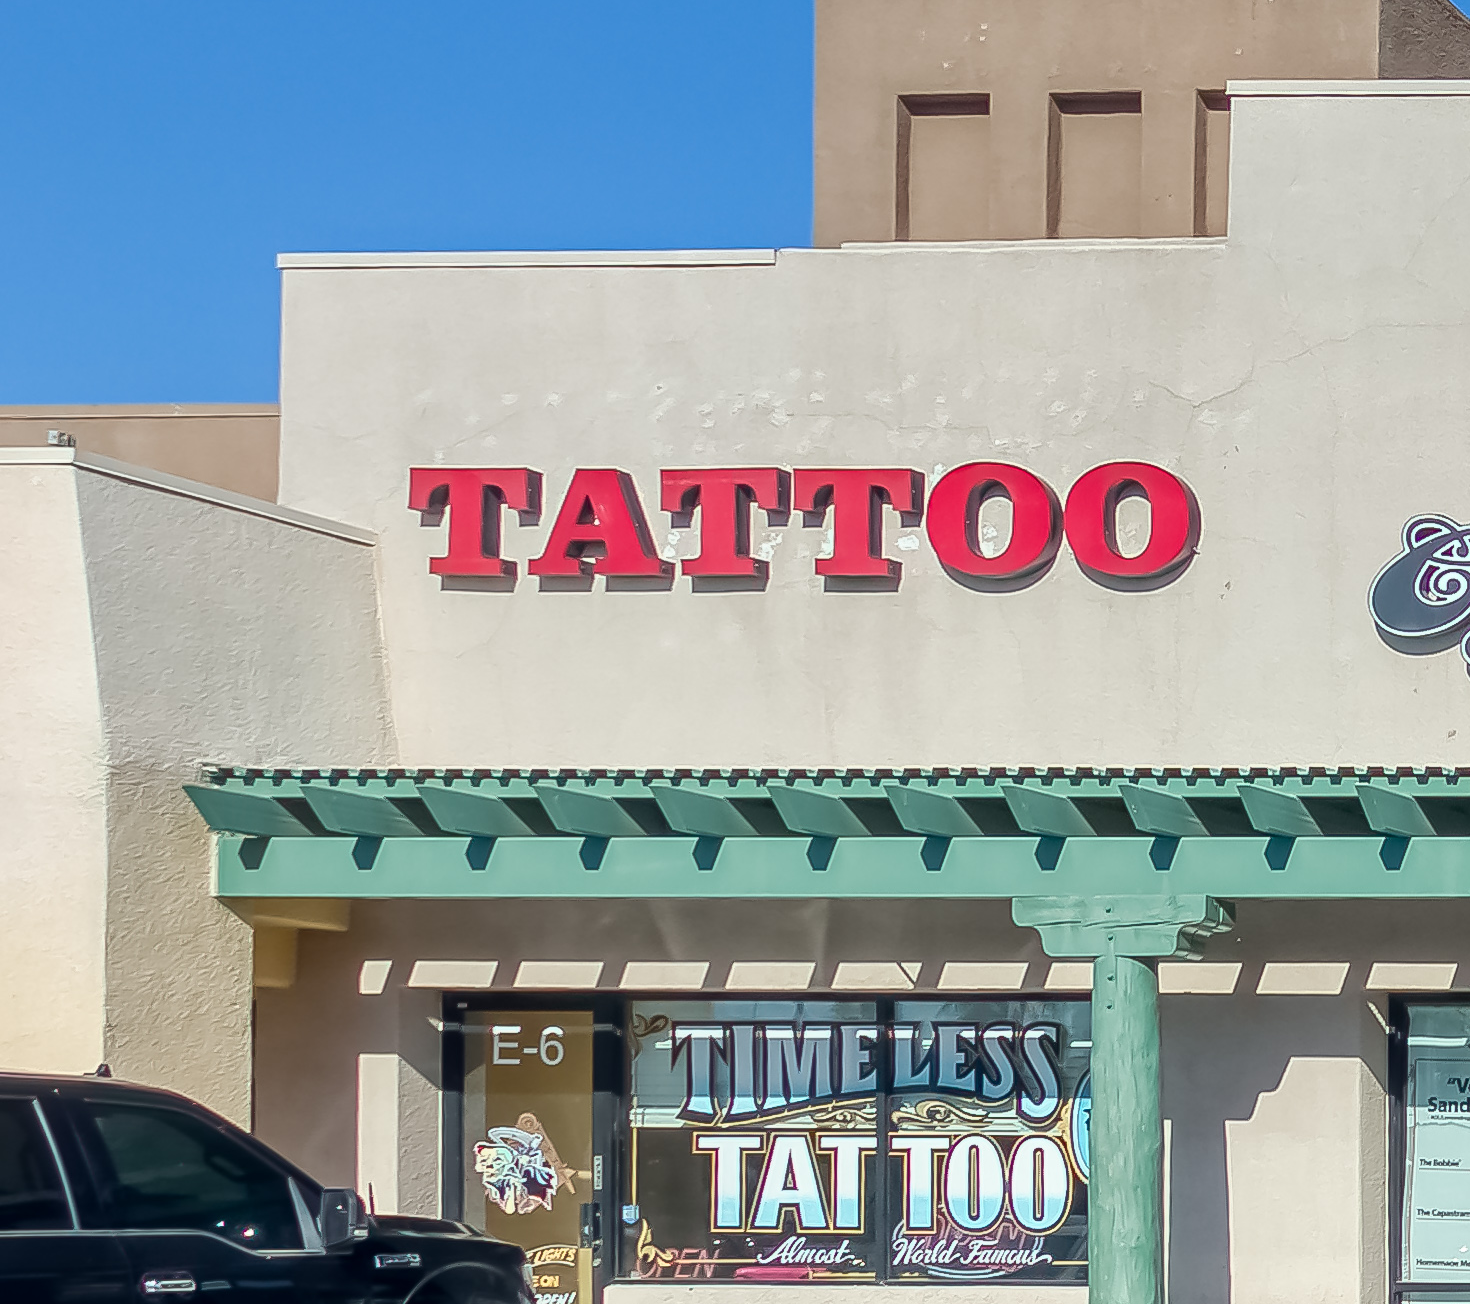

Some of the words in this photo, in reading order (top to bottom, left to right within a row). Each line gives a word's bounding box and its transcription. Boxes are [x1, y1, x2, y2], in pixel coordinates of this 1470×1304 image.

[408, 461, 1198, 583] TATTOO
[490, 1025, 566, 1067] E-6
[671, 1020, 1061, 1128] TIMELESS
[1419, 1158, 1432, 1168] The
[692, 1130, 1073, 1235] TATTOO
[1417, 1208, 1430, 1217] The
[533, 1247, 577, 1265] LIGHTS
[892, 1237, 960, 1266] World
[960, 1239, 1053, 1266] Famous
